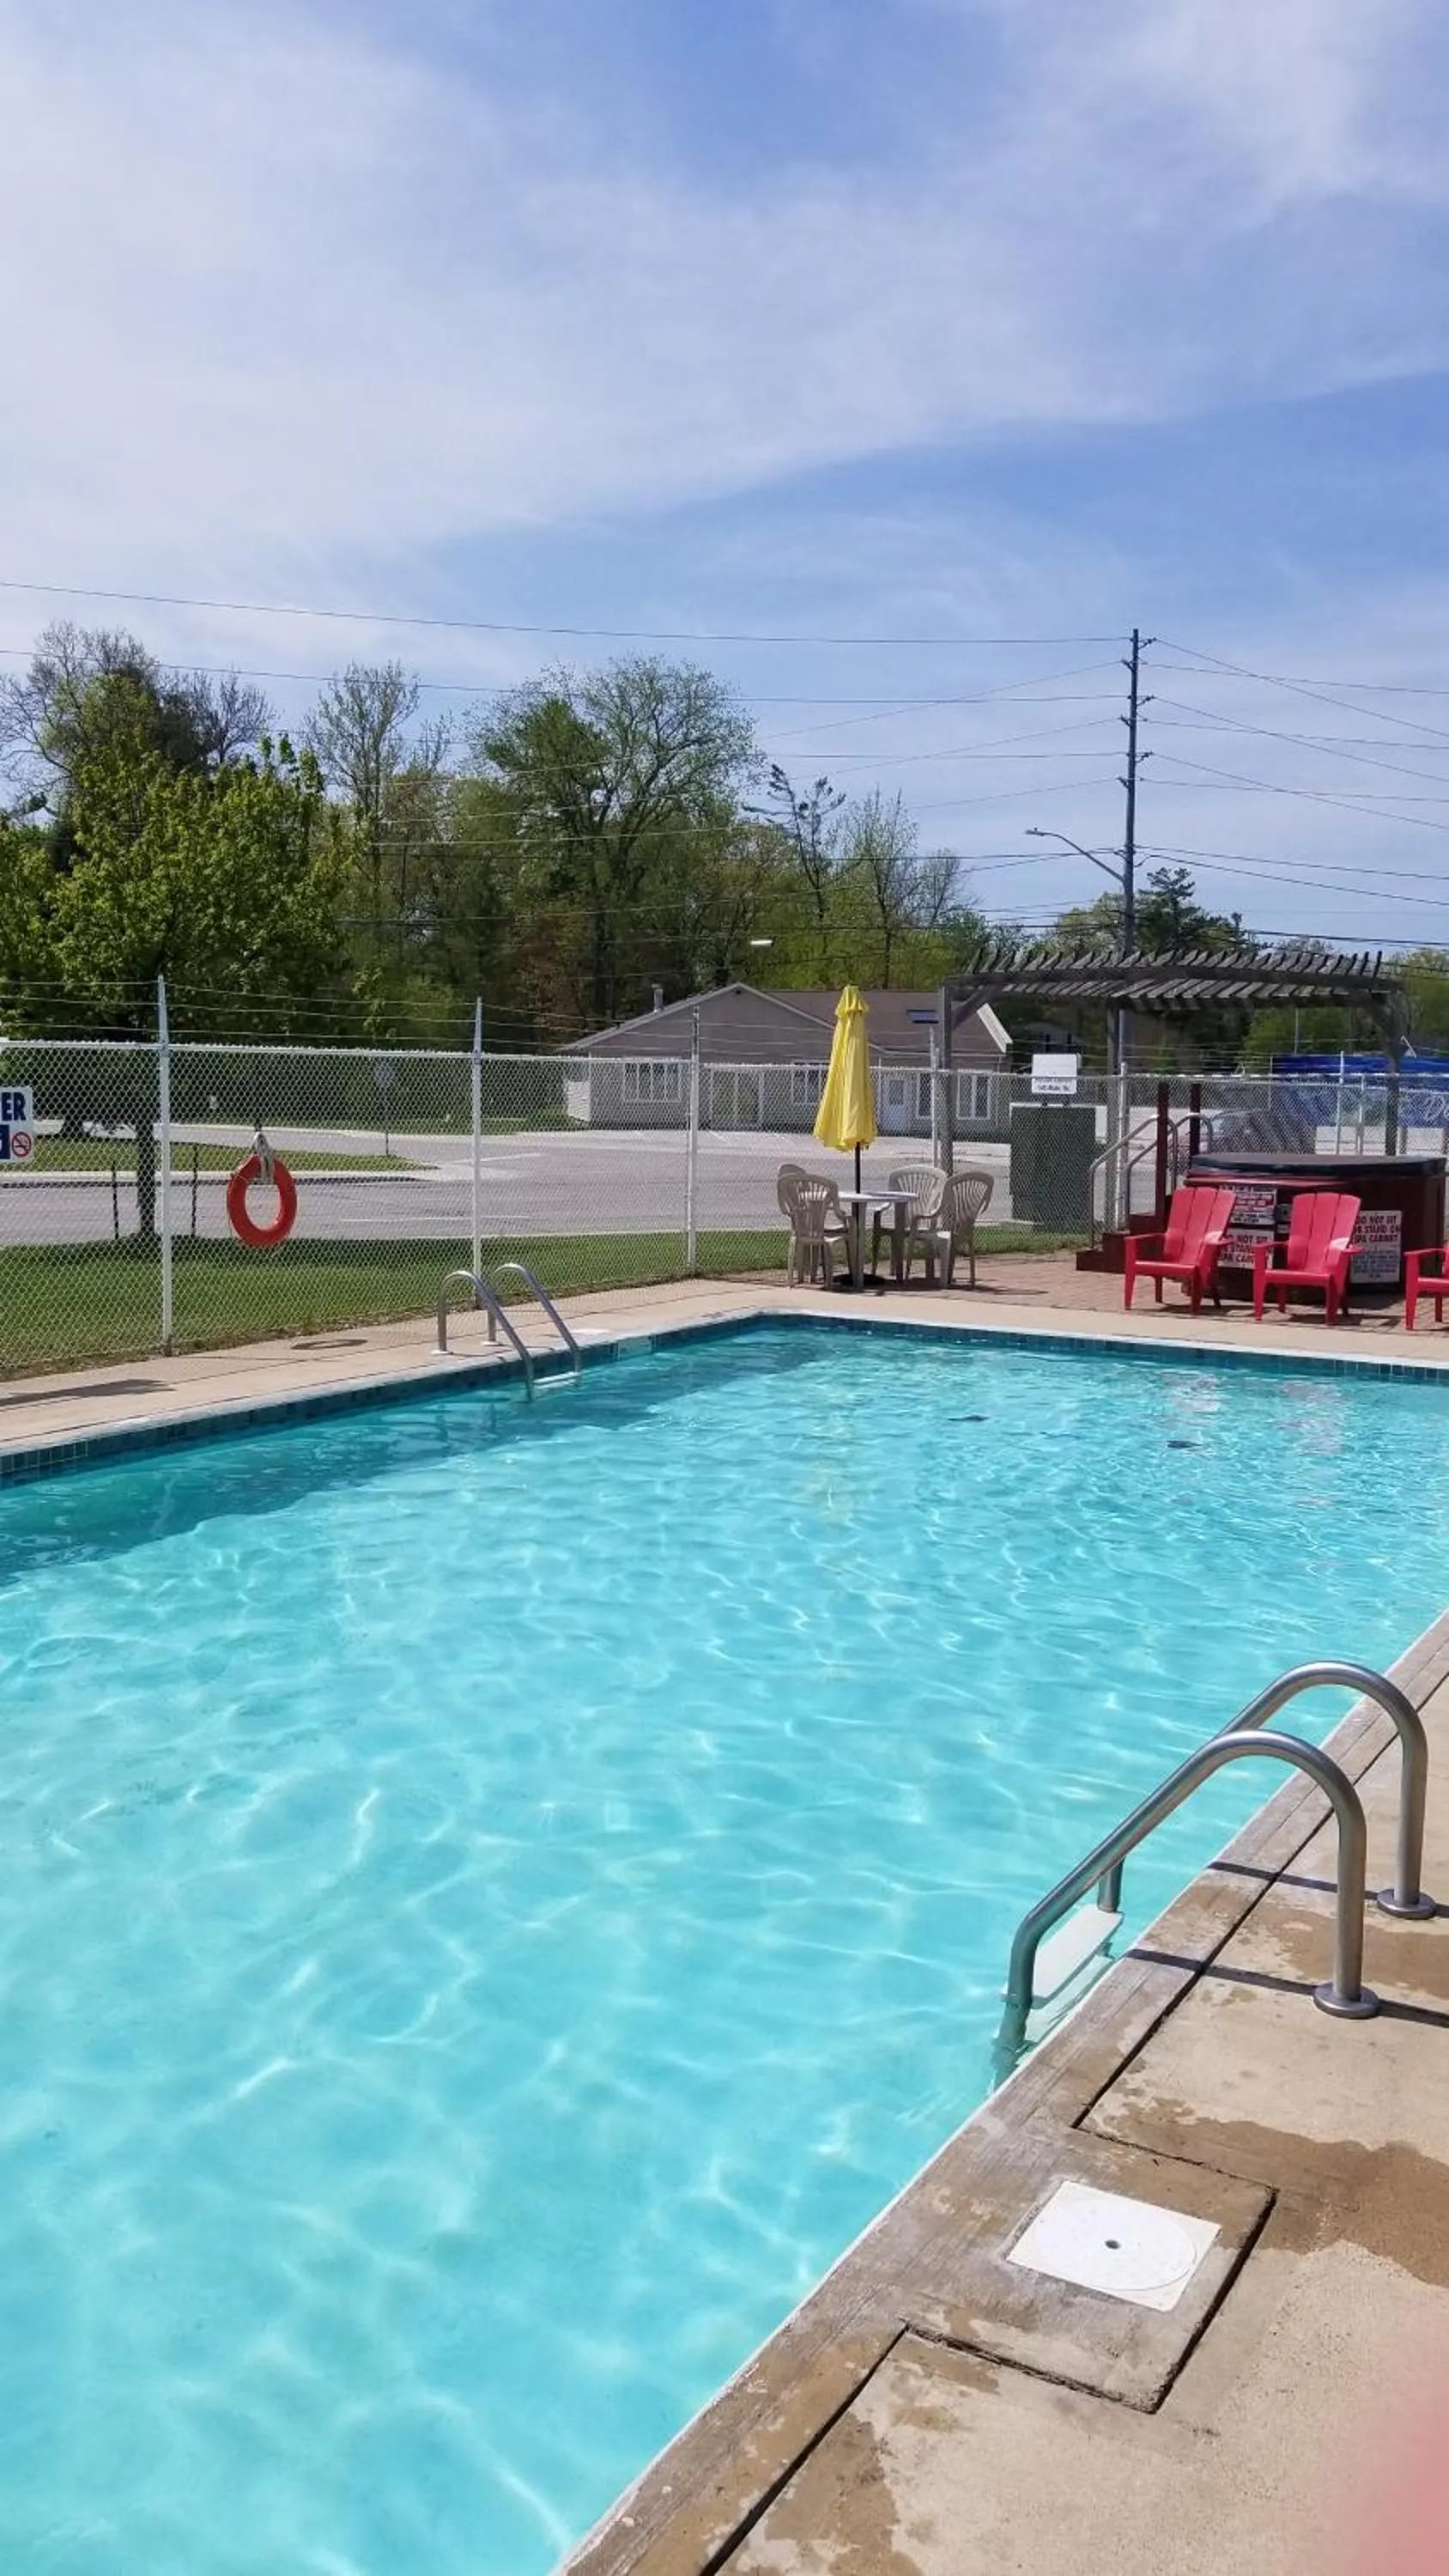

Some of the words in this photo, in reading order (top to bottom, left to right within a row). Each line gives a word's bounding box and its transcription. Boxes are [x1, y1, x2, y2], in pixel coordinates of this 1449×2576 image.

[2, 1092, 26, 1121] ER
[1369, 1215, 1385, 1224] NOT
[1237, 1235, 1254, 1245] NOT
